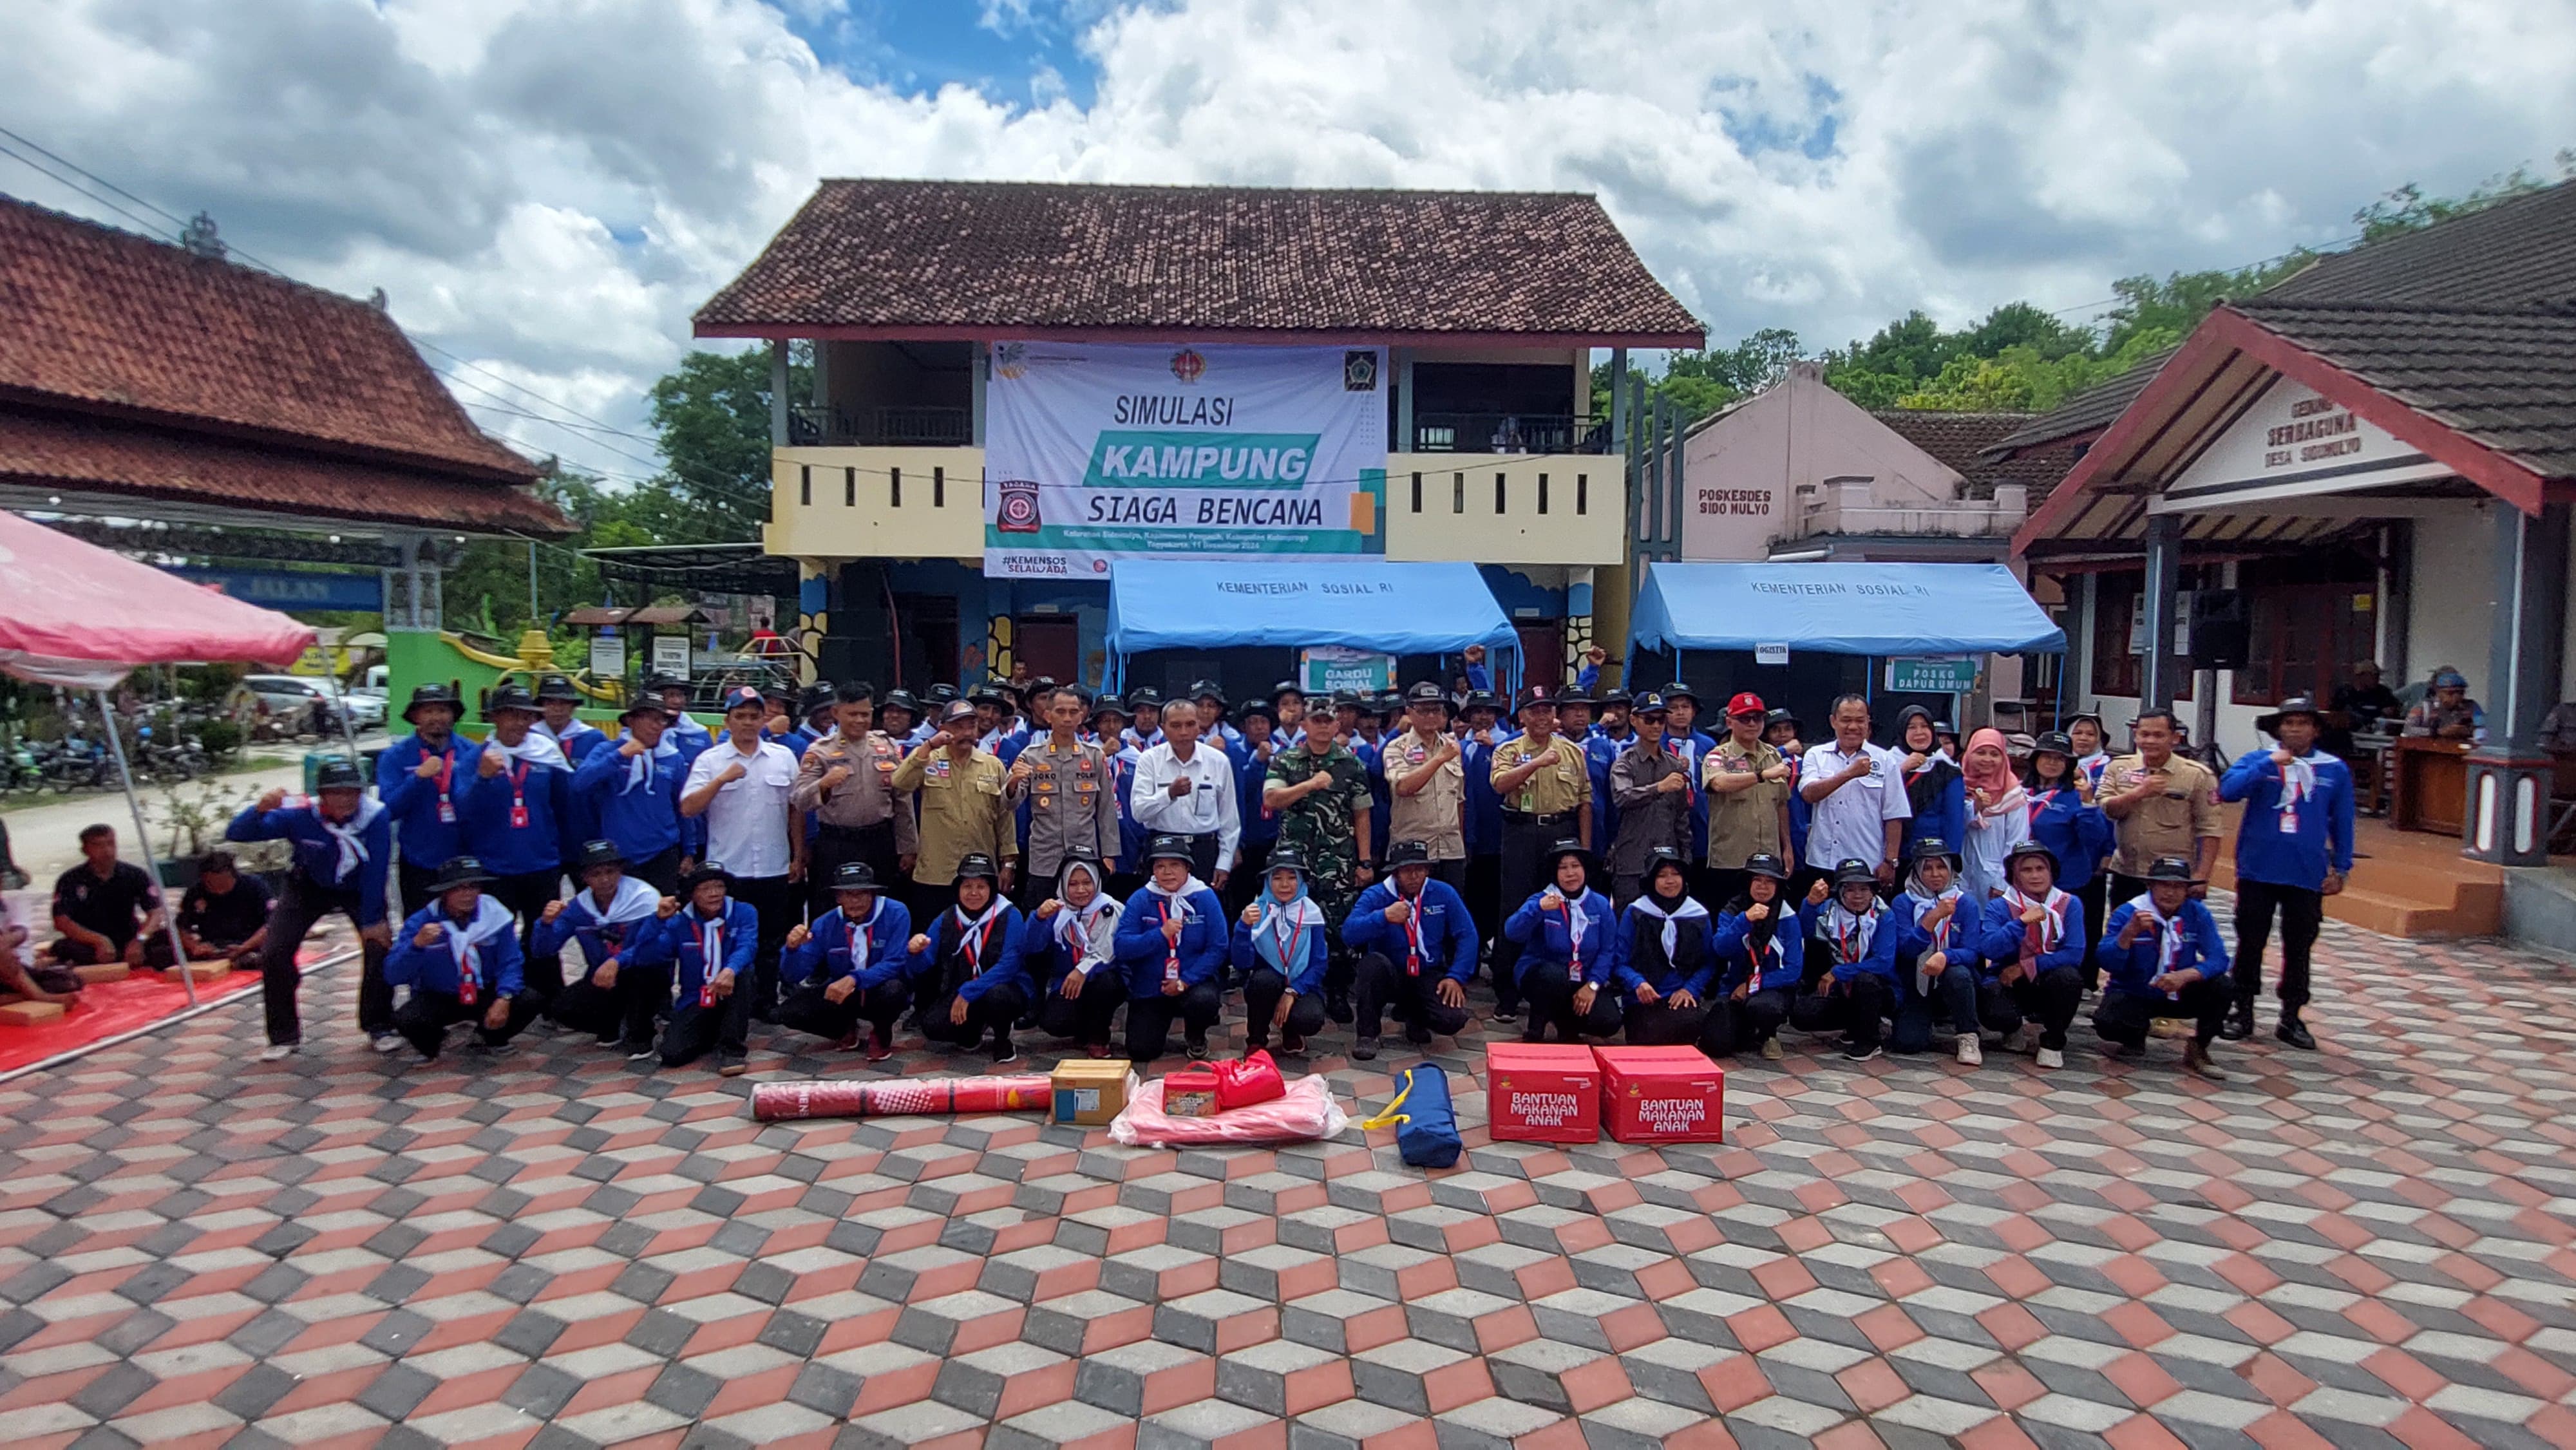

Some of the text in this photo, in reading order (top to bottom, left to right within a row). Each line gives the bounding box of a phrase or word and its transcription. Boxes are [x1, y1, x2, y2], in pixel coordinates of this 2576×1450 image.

[1114, 395, 1234, 426] SIMULASI
[2267, 412, 2356, 447] SERBAGUNA
[1101, 444, 1307, 480] KAMPUNG
[2265, 451, 2292, 467] DESA
[1699, 489, 1771, 502] POSKESDES
[1088, 495, 1323, 526] SIAGA BENCANA
[1700, 502, 1770, 515] SIDO MULYO
[1002, 556, 1067, 565] #KEMENSOS
[1217, 582, 1393, 594] KEMENTERIAN SOSIAL RI
[1751, 582, 1930, 596] KEMENTERIAN SOSIAL RI
[1325, 668, 1372, 679] GARDU
[1913, 670, 1955, 679] POSKO
[1325, 679, 1375, 690] SOSIAL
[1899, 679, 1971, 690] DAPUR UMUM
[1512, 1093, 1577, 1105] BANTUAN
[1640, 1099, 1703, 1111] BANTUAN
[1510, 1103, 1578, 1116] MAKANAN
[1638, 1109, 1705, 1122] MAKANAN
[1525, 1115, 1562, 1126] ANAK
[1653, 1120, 1690, 1132] ANAK
